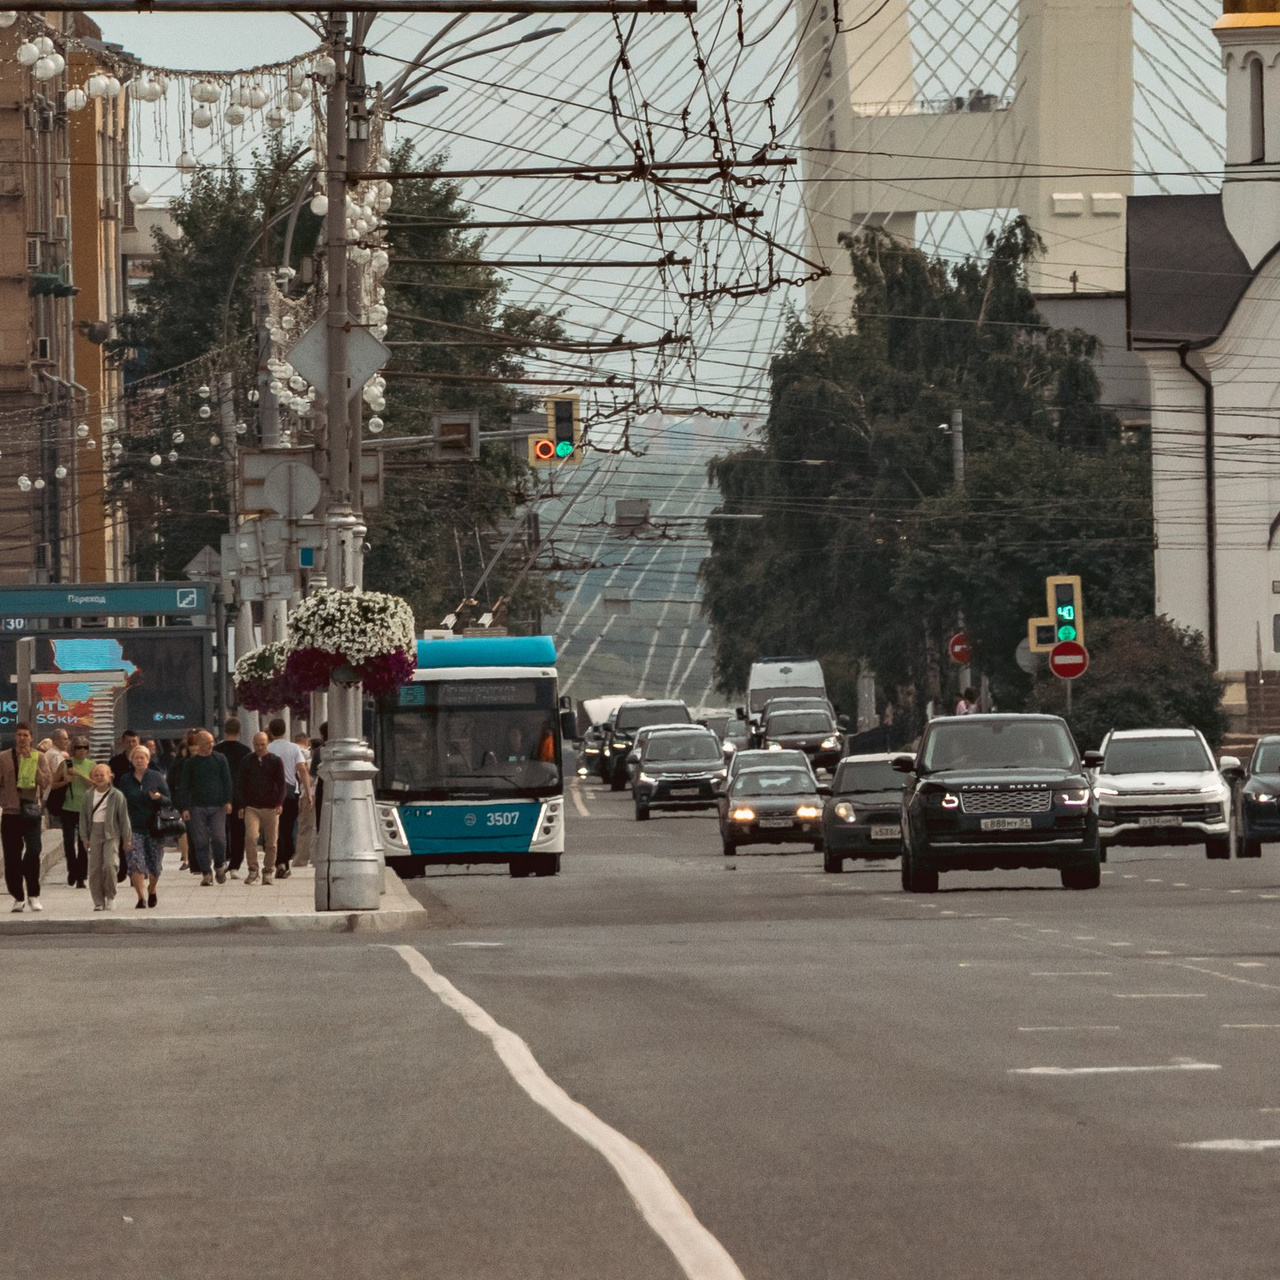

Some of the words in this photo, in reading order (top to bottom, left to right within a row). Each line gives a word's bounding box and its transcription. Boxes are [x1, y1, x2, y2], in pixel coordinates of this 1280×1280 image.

[67, 594, 106, 604] Переход
[1057, 606, 1074, 620] 40
[6, 618, 24, 630] 30
[486, 811, 520, 826] 3507
